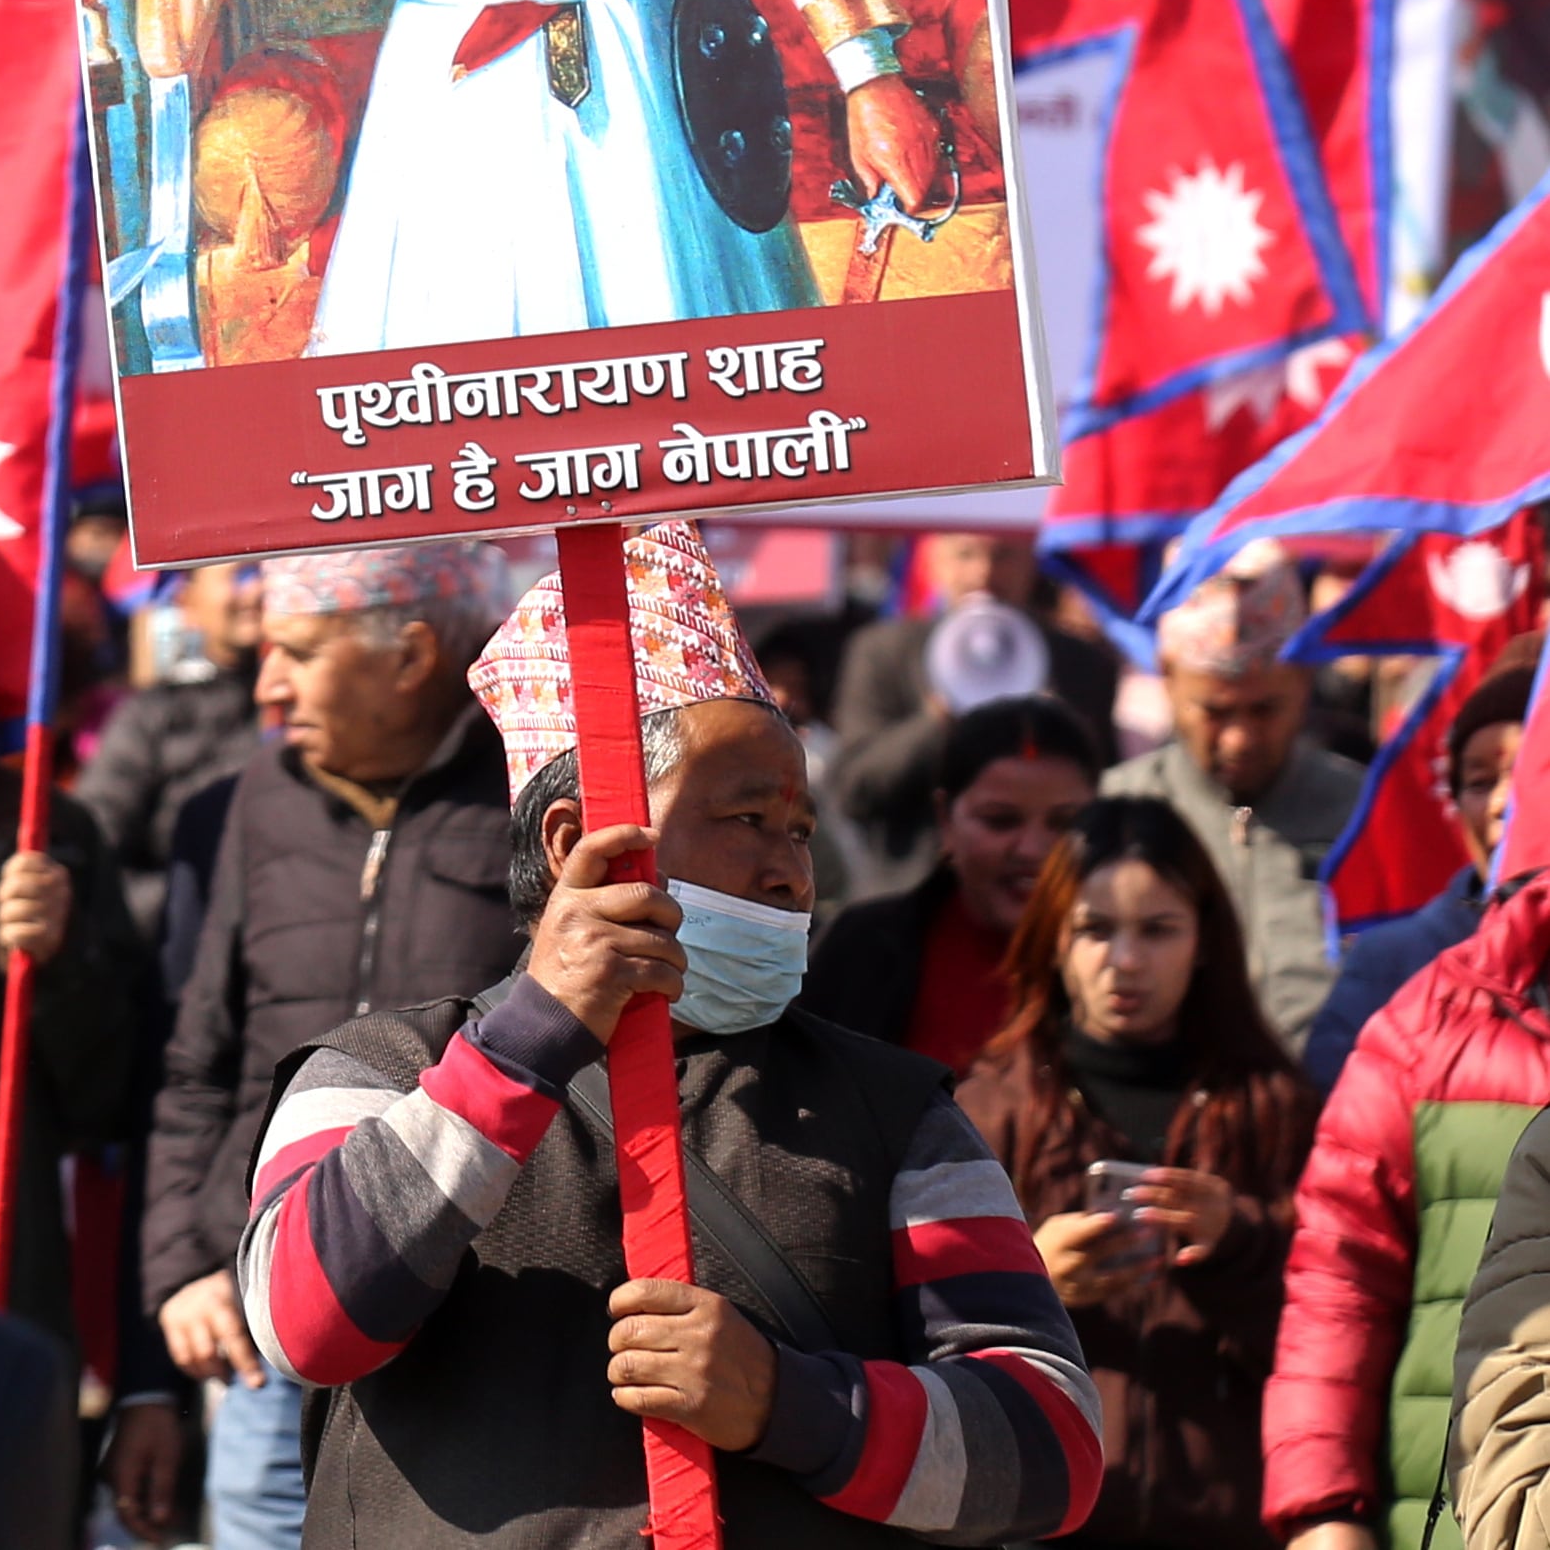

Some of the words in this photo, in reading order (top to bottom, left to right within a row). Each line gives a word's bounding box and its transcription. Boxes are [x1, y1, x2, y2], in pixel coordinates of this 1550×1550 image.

[316, 351, 688, 445] पृथ्वीनारायण
[706, 338, 824, 397] शाह
[450, 441, 497, 510] है
[514, 442, 642, 499] जाग
